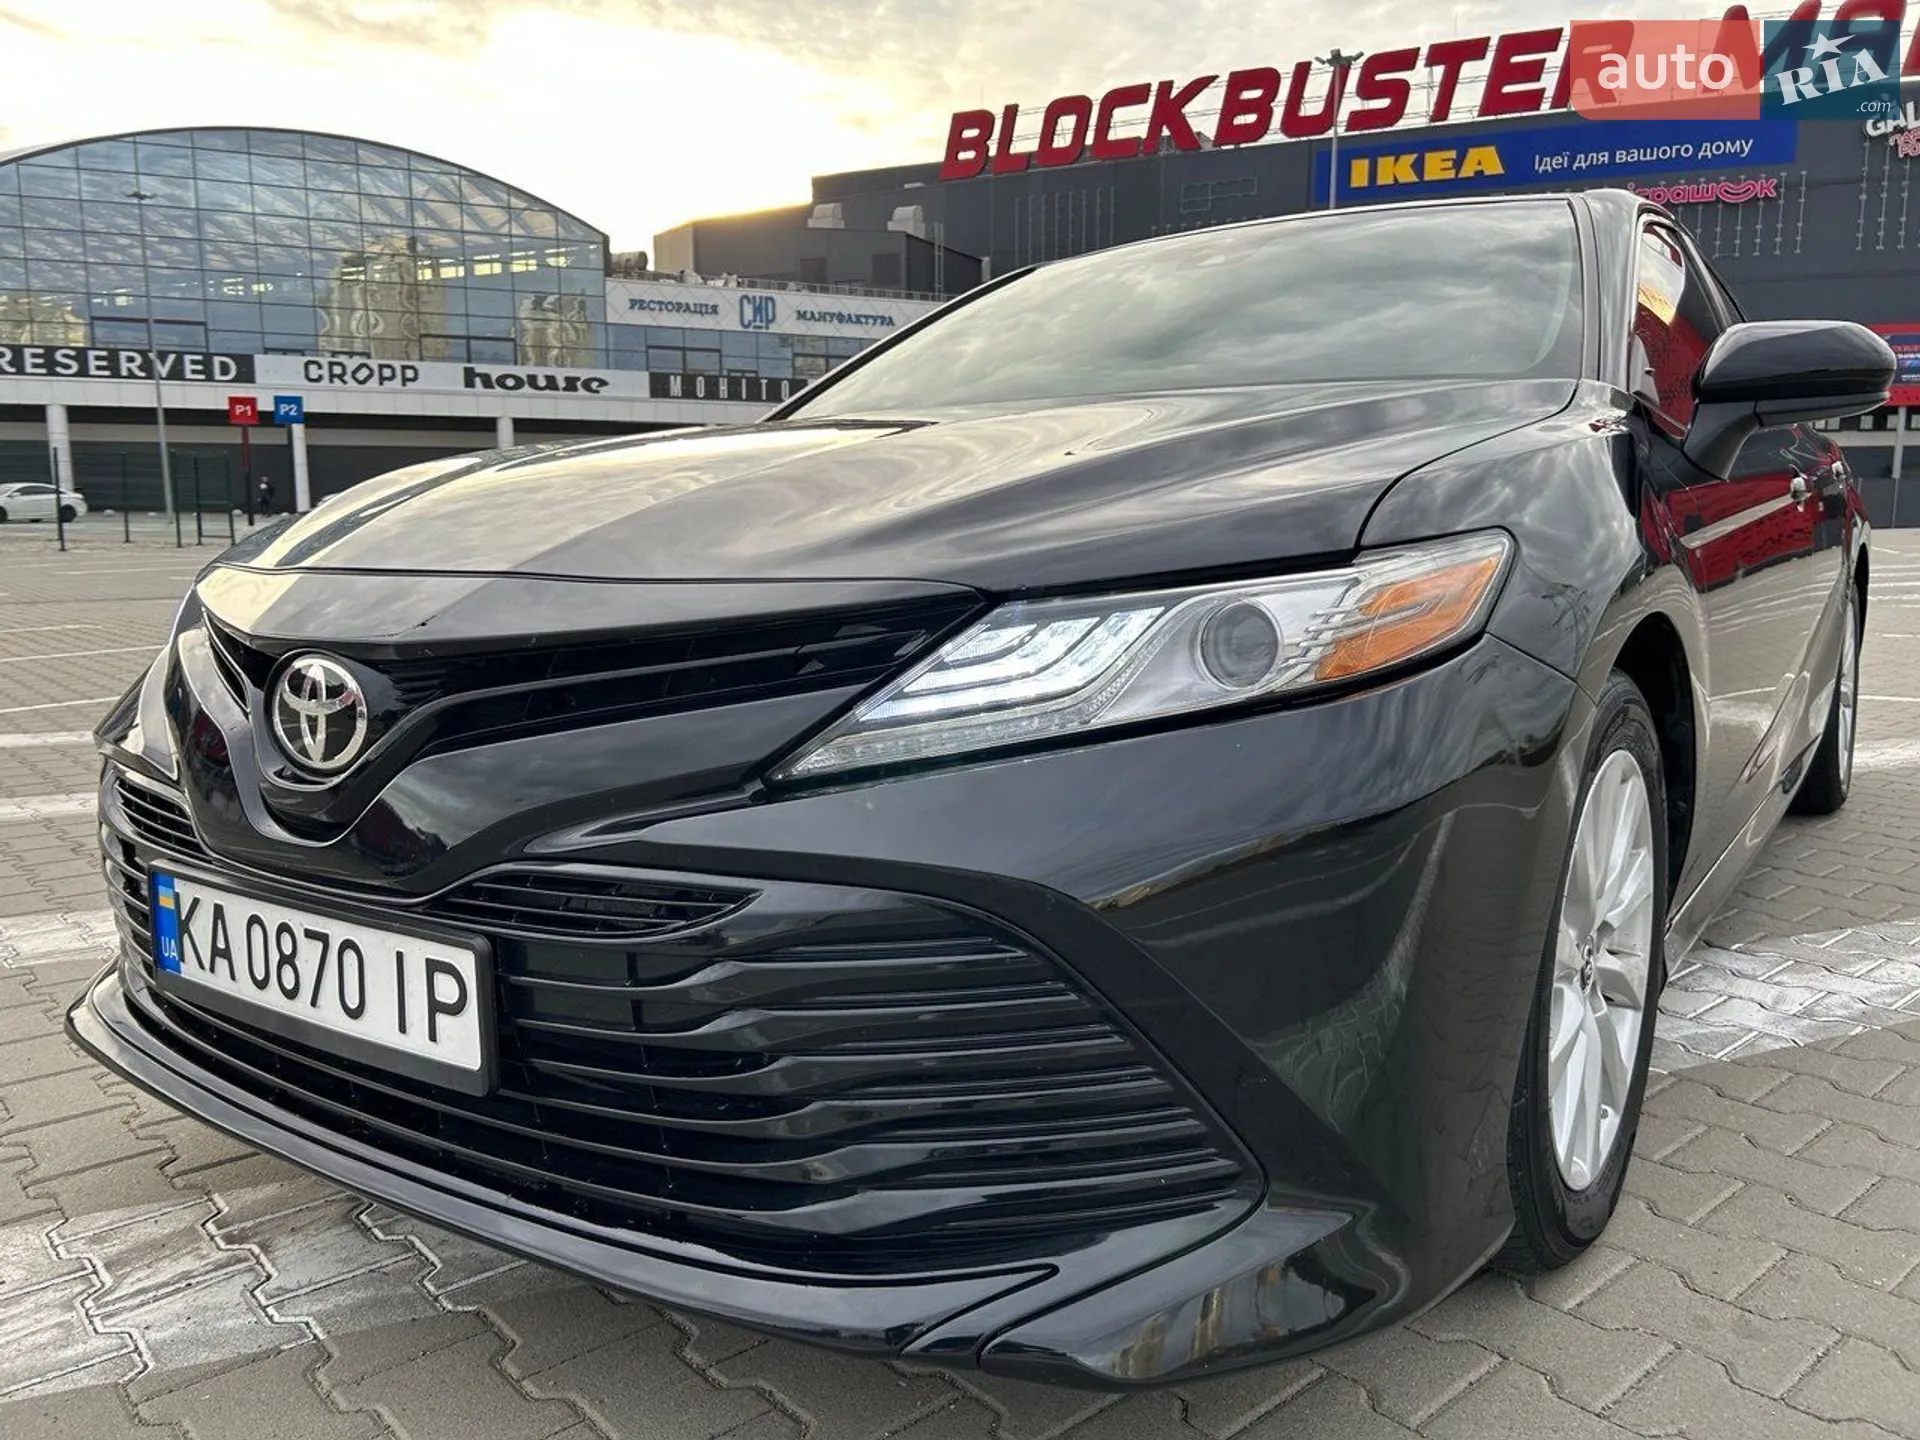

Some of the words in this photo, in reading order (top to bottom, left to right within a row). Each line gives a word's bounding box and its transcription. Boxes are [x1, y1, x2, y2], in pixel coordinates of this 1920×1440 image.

[940, 20, 1635, 180] BLOCKBUSTER
[1349, 145, 1504, 189] IKEA
[1533, 151, 1570, 174] Ідеї
[1573, 152, 1609, 170] для
[1614, 145, 1693, 165] вашого
[1697, 137, 1754, 160] дому
[628, 298, 720, 315] РЕСТОРАЦІЯ
[796, 309, 895, 327] МАНУФАКТУРА
[0, 346, 238, 381] RESERVED
[303, 359, 419, 386] CROPP
[463, 366, 609, 393] house
[669, 375, 790, 400] MOHITO
[235, 405, 252, 417] P1
[279, 403, 298, 417] P2
[161, 936, 178, 960] UA
